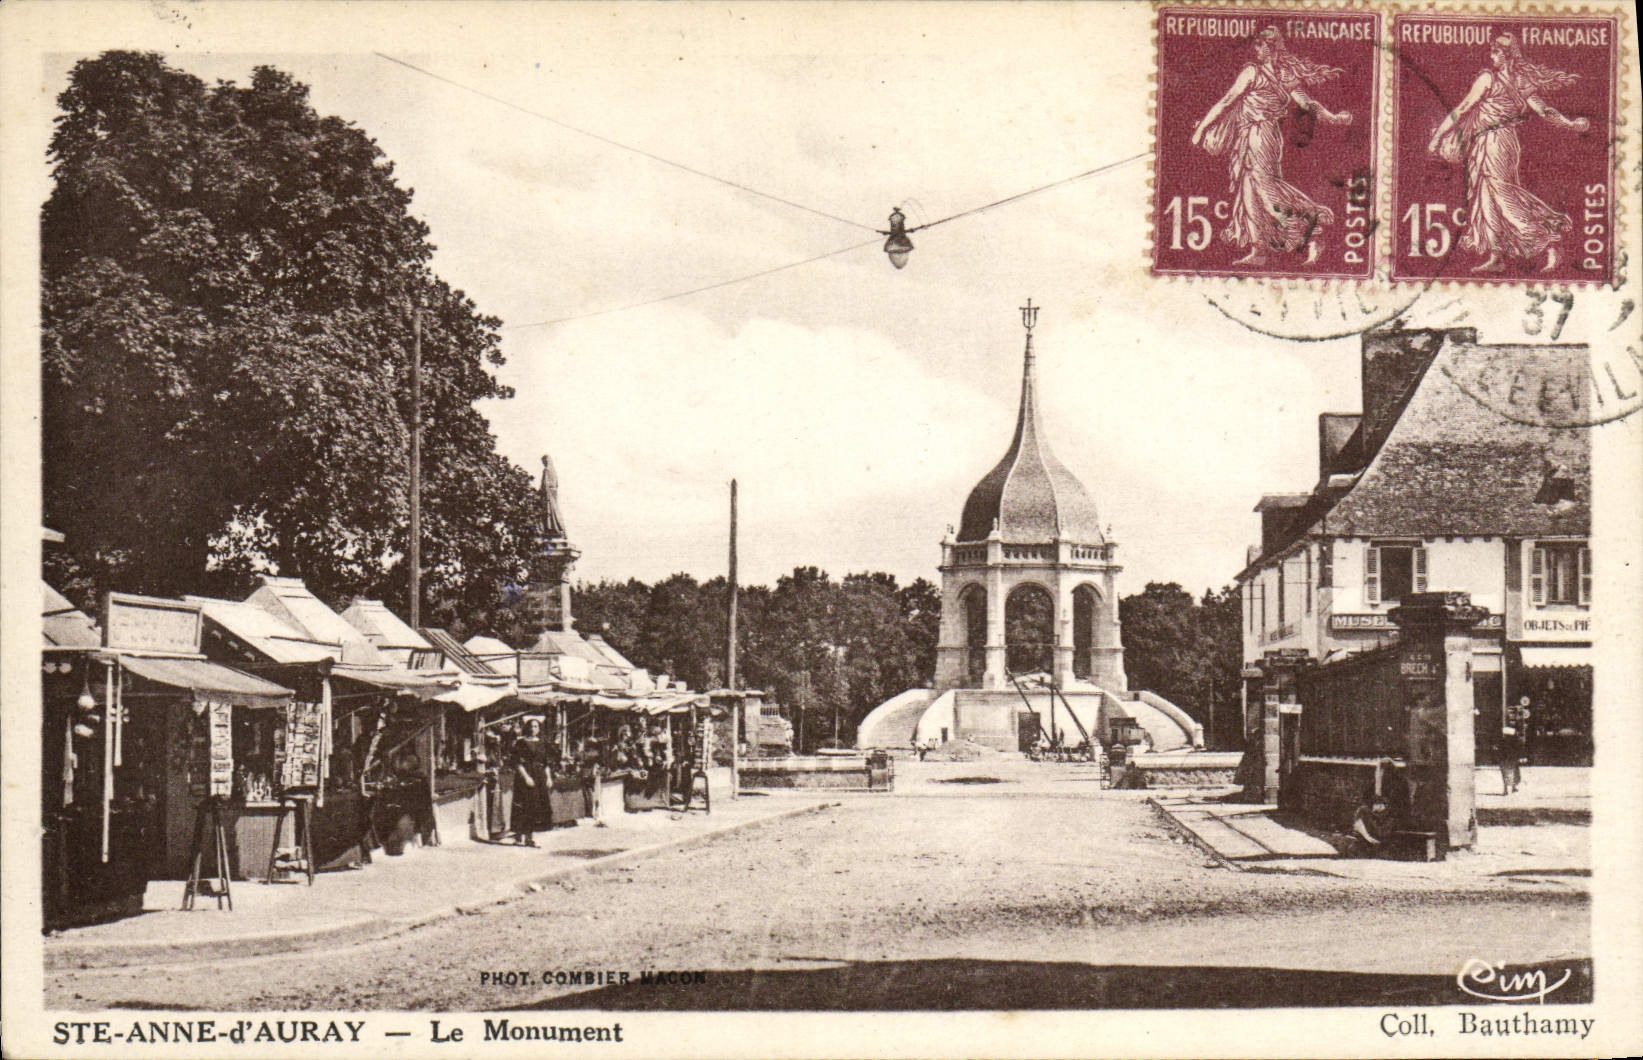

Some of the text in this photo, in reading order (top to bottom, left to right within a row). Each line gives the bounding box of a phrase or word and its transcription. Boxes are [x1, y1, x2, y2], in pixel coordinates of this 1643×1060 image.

[1402, 23, 1608, 48] REPUBLIQUE FRANÇAISE
[1582, 182, 1606, 270] POSTES
[1524, 620, 1565, 632] OBJETS
